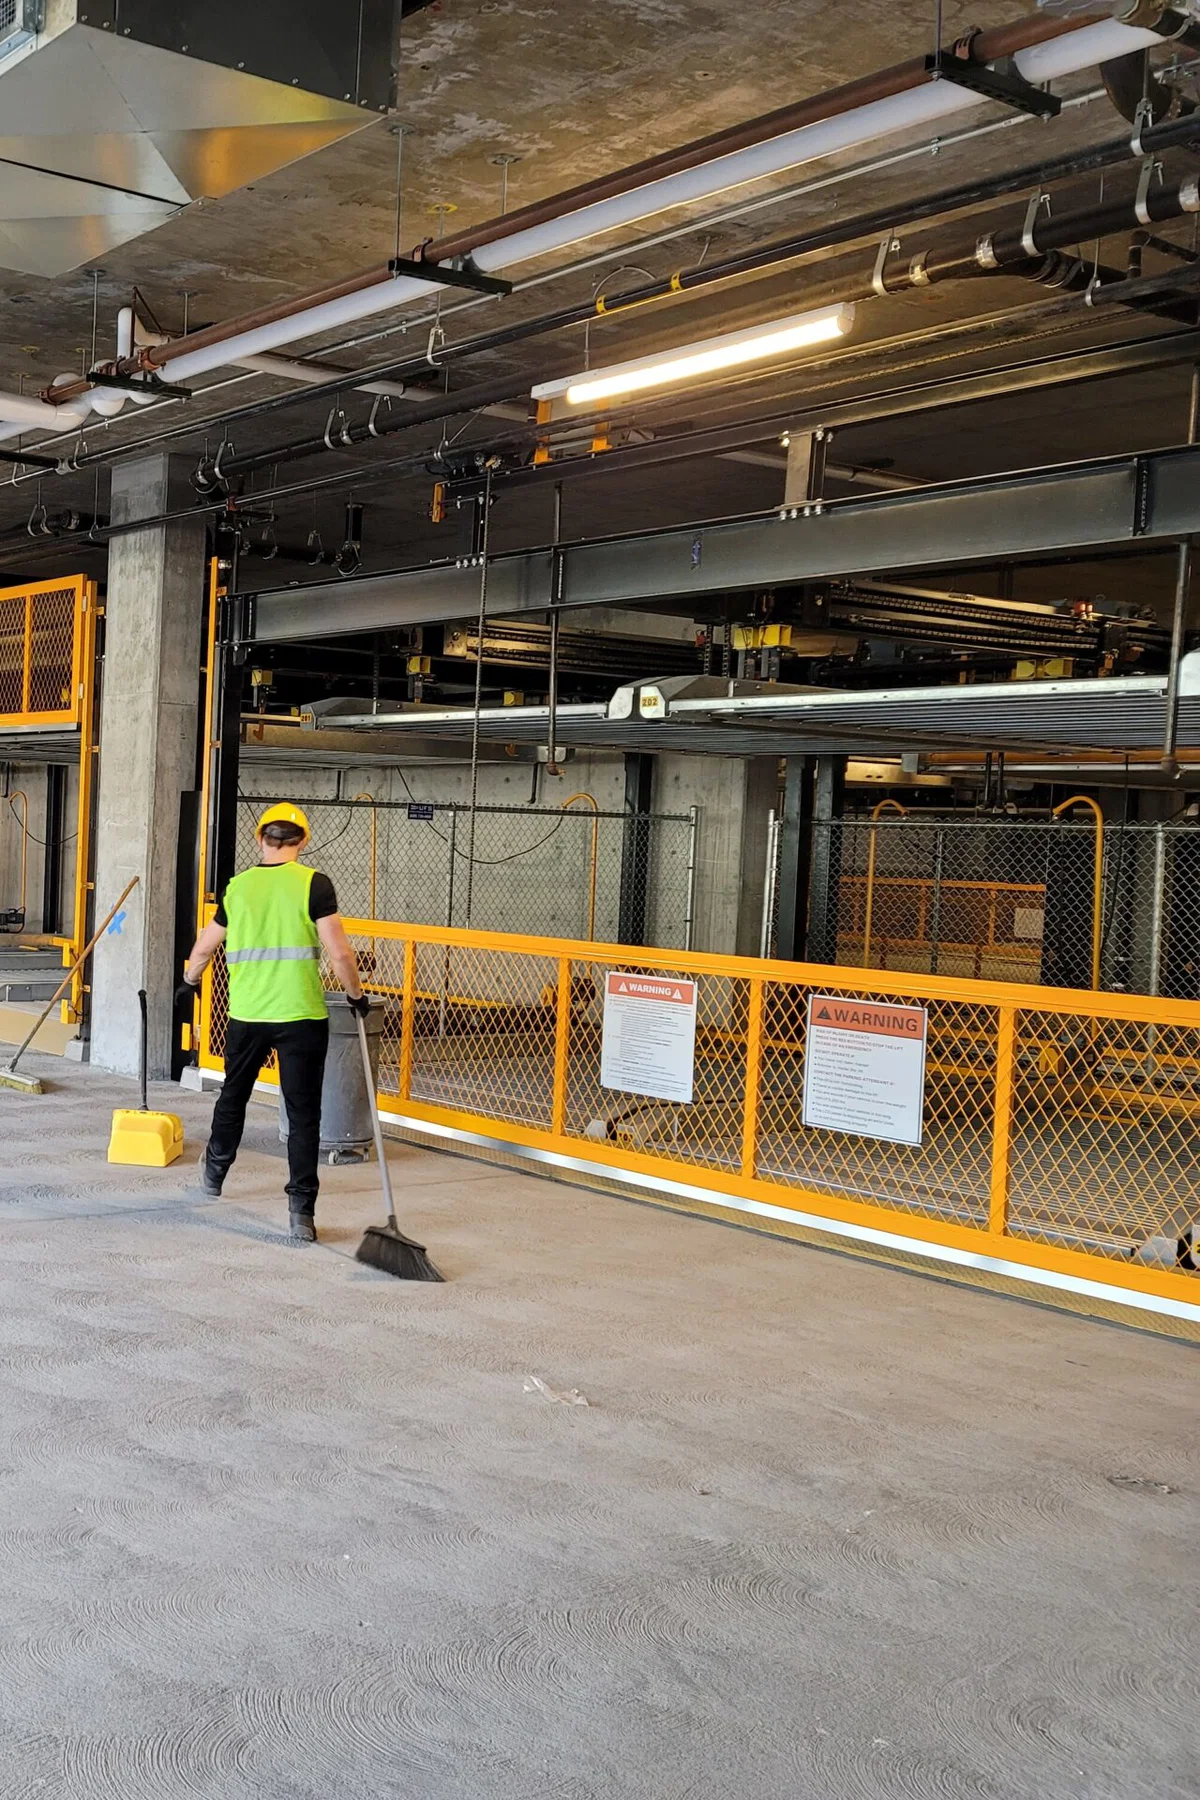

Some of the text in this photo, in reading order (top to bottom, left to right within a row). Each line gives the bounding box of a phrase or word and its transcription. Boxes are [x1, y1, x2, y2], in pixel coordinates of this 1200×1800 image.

[642, 698, 658, 706] 202
[629, 982, 672, 996] WARNING
[834, 1008, 918, 1032] WARNING
